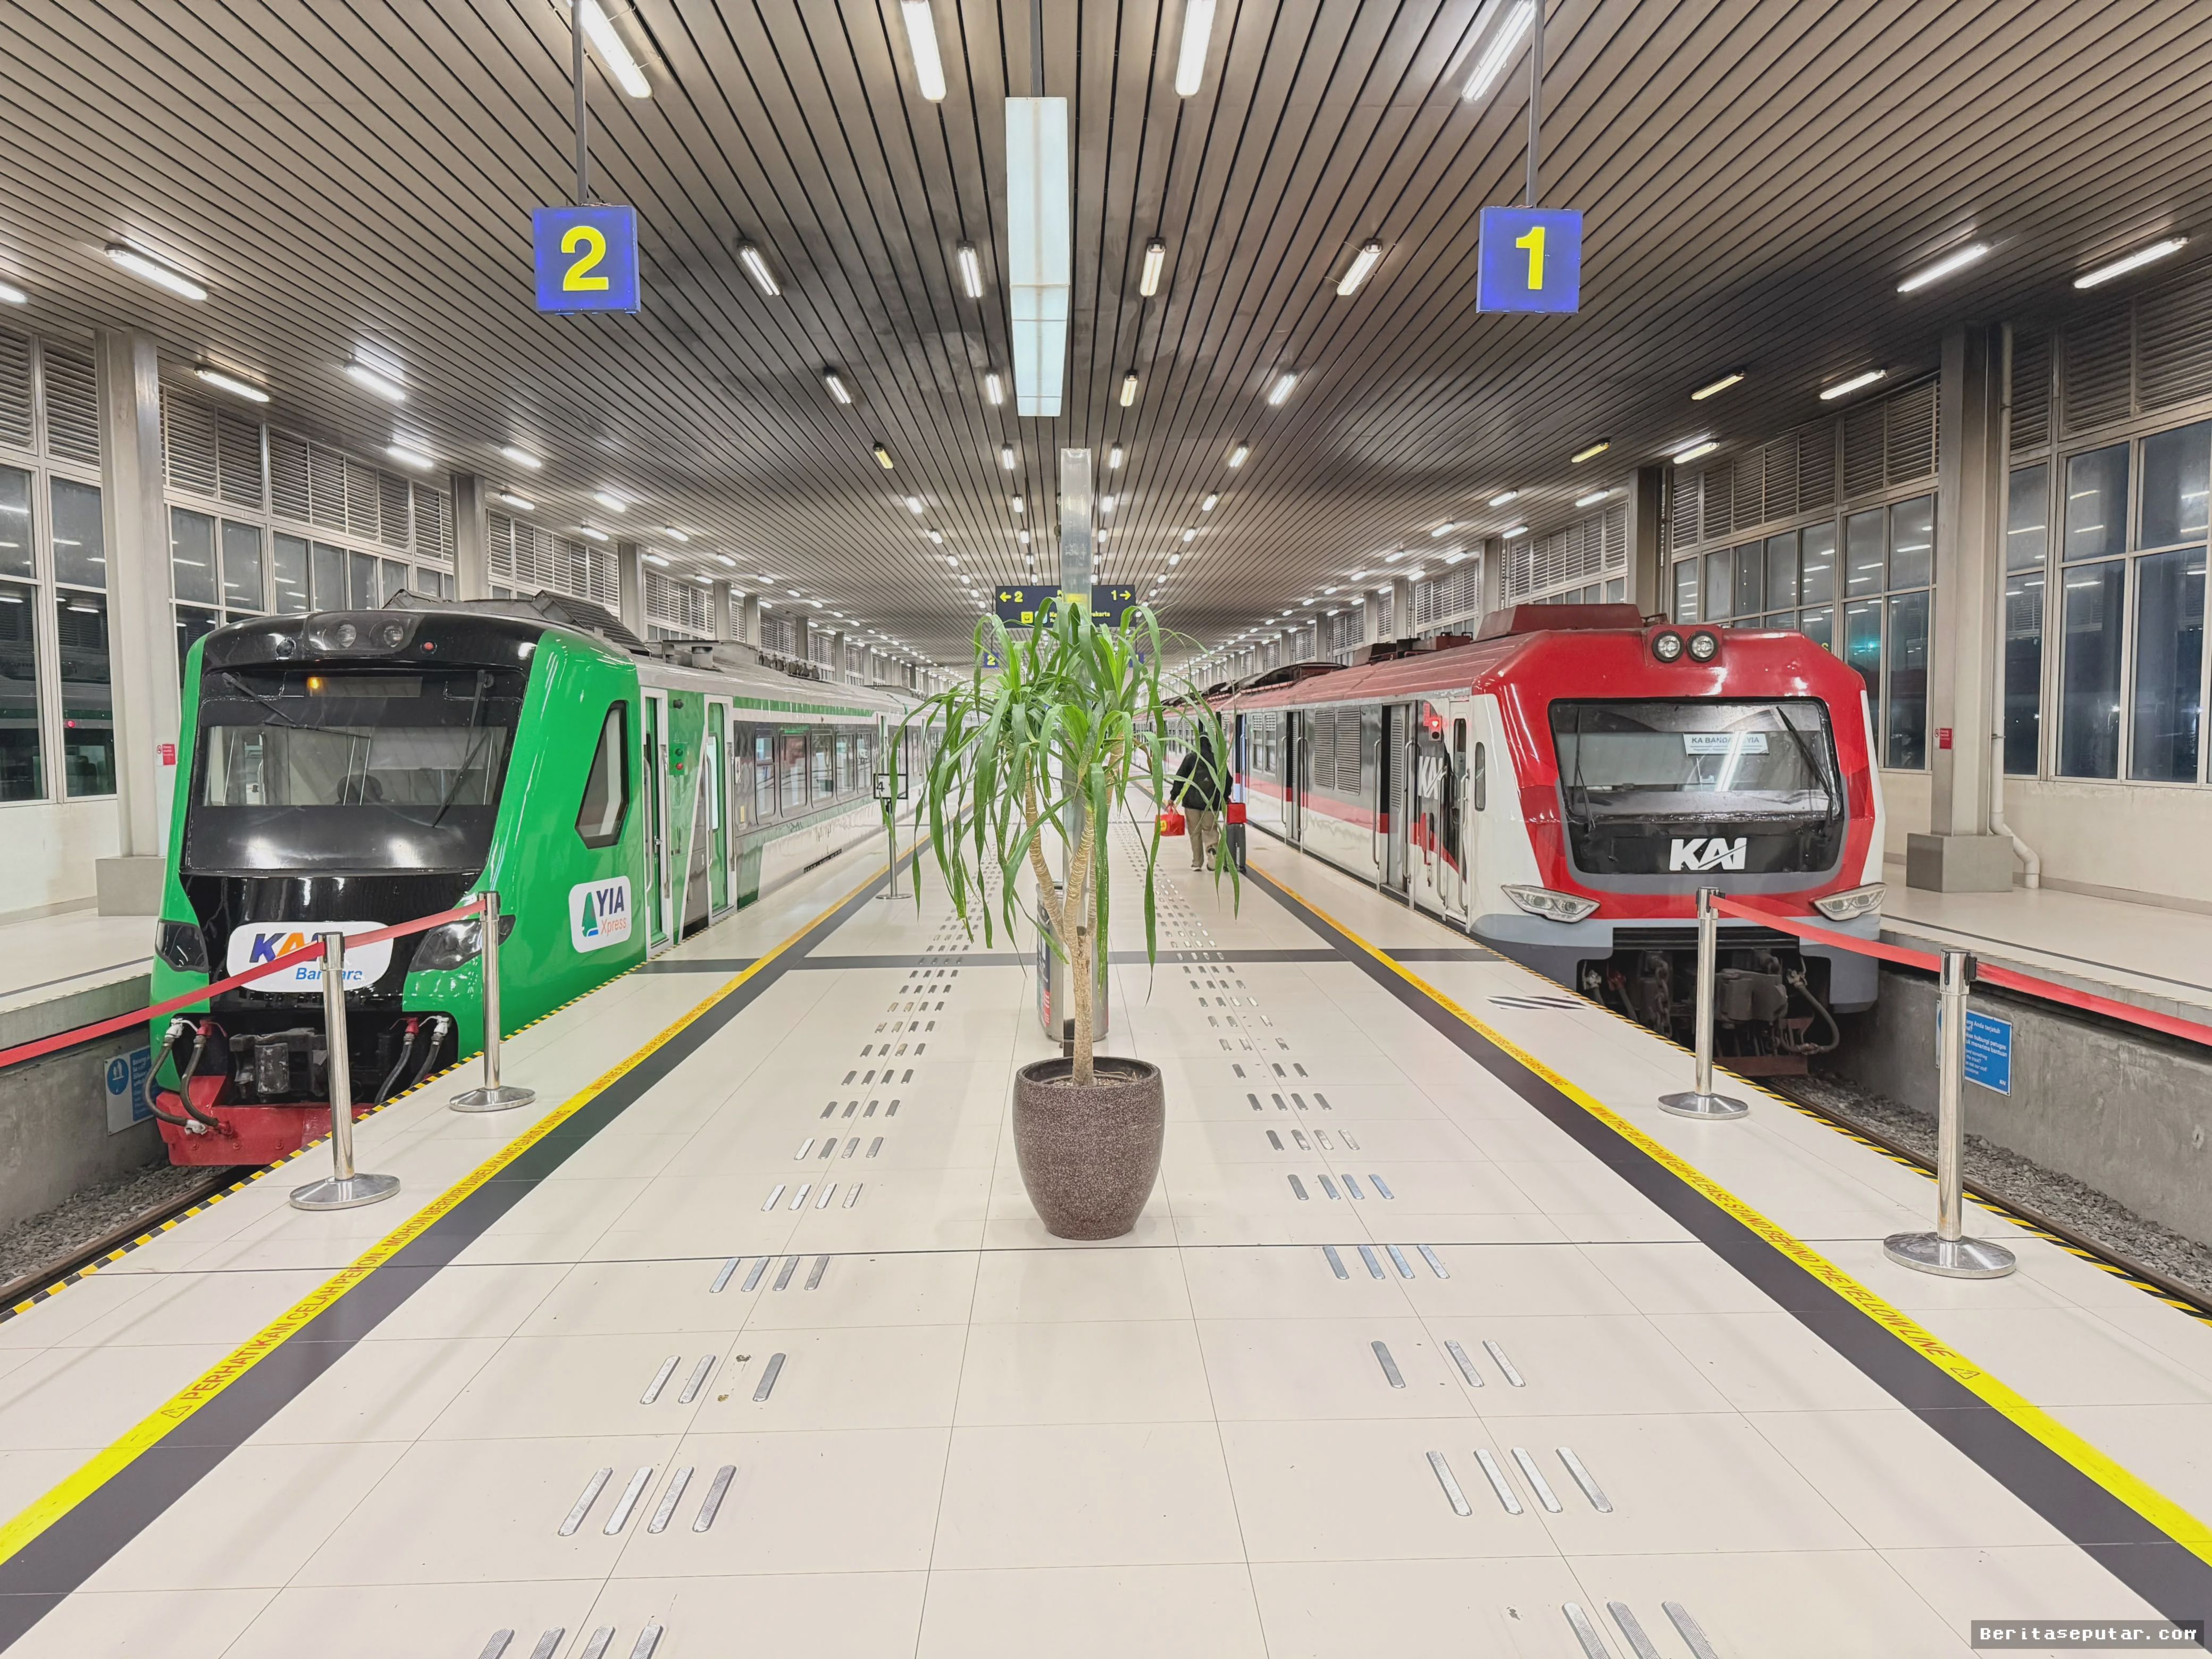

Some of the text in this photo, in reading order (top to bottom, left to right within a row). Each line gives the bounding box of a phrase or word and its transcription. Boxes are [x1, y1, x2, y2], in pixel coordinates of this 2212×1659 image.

[561, 225, 609, 291] 2
[1516, 227, 1545, 290] 1
[1014, 591, 1023, 602] 2
[1111, 590, 1117, 601] 1
[987, 655, 995, 665] 2
[876, 782, 885, 792] 4
[1669, 837, 1747, 871] KAI
[596, 886, 624, 917] YIA
[601, 917, 627, 936] Xpress
[249, 933, 320, 963] KA
[1589, 1107, 1617, 1119] MIND
[1608, 1120, 1633, 1130] THE
[1623, 1130, 1677, 1161] PLATFORM
[1724, 1203, 1772, 1229] STAND
[1761, 1229, 1820, 1262] BEHIND
[1809, 1264, 1852, 1284] THE
[1838, 1286, 1915, 1329] YELLOW
[1899, 1329, 1956, 1358] LINE
[179, 1323, 297, 1400] PERHATIKAN
[287, 1287, 345, 1320] CELAH
[332, 1253, 387, 1284] PERON
[381, 1217, 433, 1246] MOHON
[422, 1187, 472, 1215] BERDIRI
[460, 1147, 522, 1186] DIBELAKANG
[514, 1130, 544, 1146] GARIS
[535, 1110, 572, 1129] KUNING
